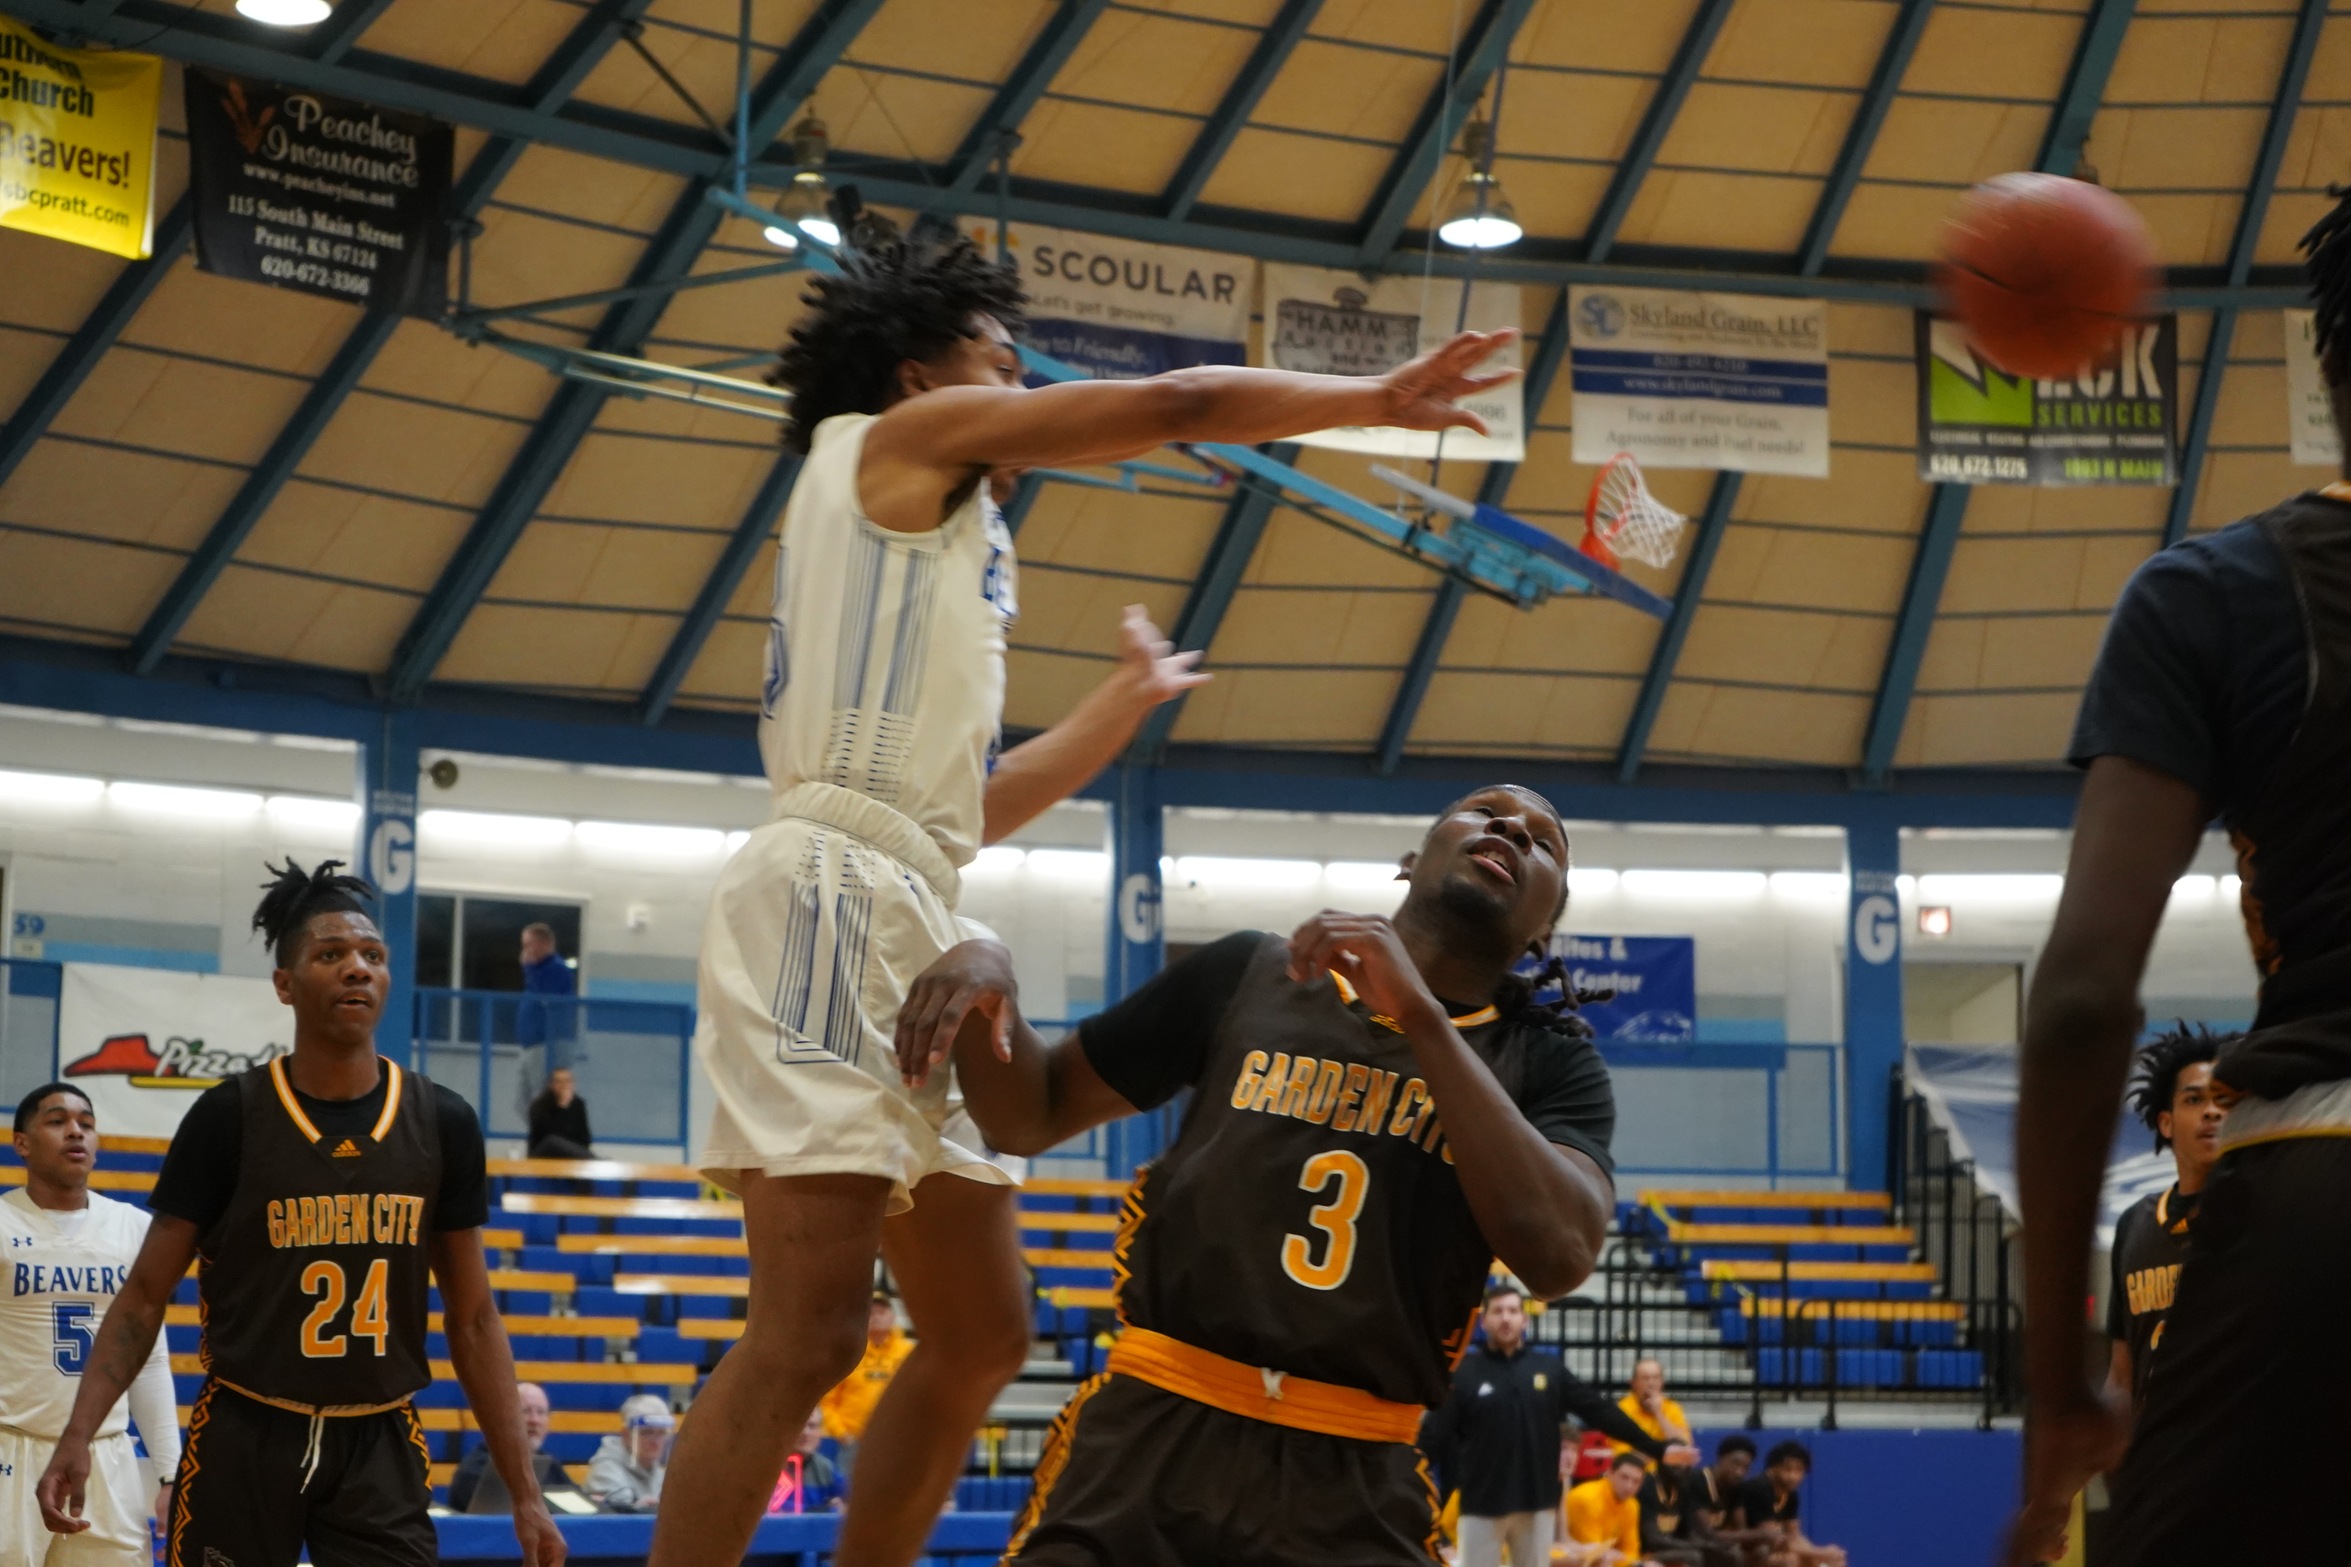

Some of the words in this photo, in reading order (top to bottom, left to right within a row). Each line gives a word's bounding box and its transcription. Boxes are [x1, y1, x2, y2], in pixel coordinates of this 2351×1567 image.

[0, 121, 130, 188] Beavers!
[262, 124, 418, 187] Insurance
[283, 95, 416, 164] Peachey
[228, 194, 255, 216] 115
[256, 199, 308, 228] South
[312, 210, 353, 238] Main
[356, 220, 404, 250] Street
[254, 225, 303, 256] Pratt,
[307, 236, 330, 259] KS
[332, 243, 378, 270] 67124
[1033, 246, 1236, 304] SCOULAR
[1297, 307, 1387, 337] HAMM
[1629, 303, 1706, 329] Skyland
[1777, 314, 1818, 336] LLC
[1606, 430, 1686, 449] Agronomy
[1690, 432, 1719, 449] and
[1627, 406, 1652, 423] For
[1657, 407, 1676, 424] all
[1679, 408, 1697, 424] of
[1700, 413, 1731, 430] your
[2038, 402, 2162, 428] SERVICES
[370, 820, 412, 895] G
[1855, 895, 1898, 965] G
[1572, 967, 1643, 994] Center
[154, 1036, 250, 1078] Pizza
[1231, 1049, 1400, 1136] GARDEN
[1388, 1077, 1456, 1165] CIT
[267, 1194, 370, 1248] GARDEN
[373, 1193, 425, 1247] CITY
[1281, 1149, 1370, 1290] 3
[14, 1262, 127, 1297] BEAVERS
[2126, 1263, 2183, 1316] GARDE
[300, 1259, 389, 1358] 24
[52, 1301, 95, 1376] 5
